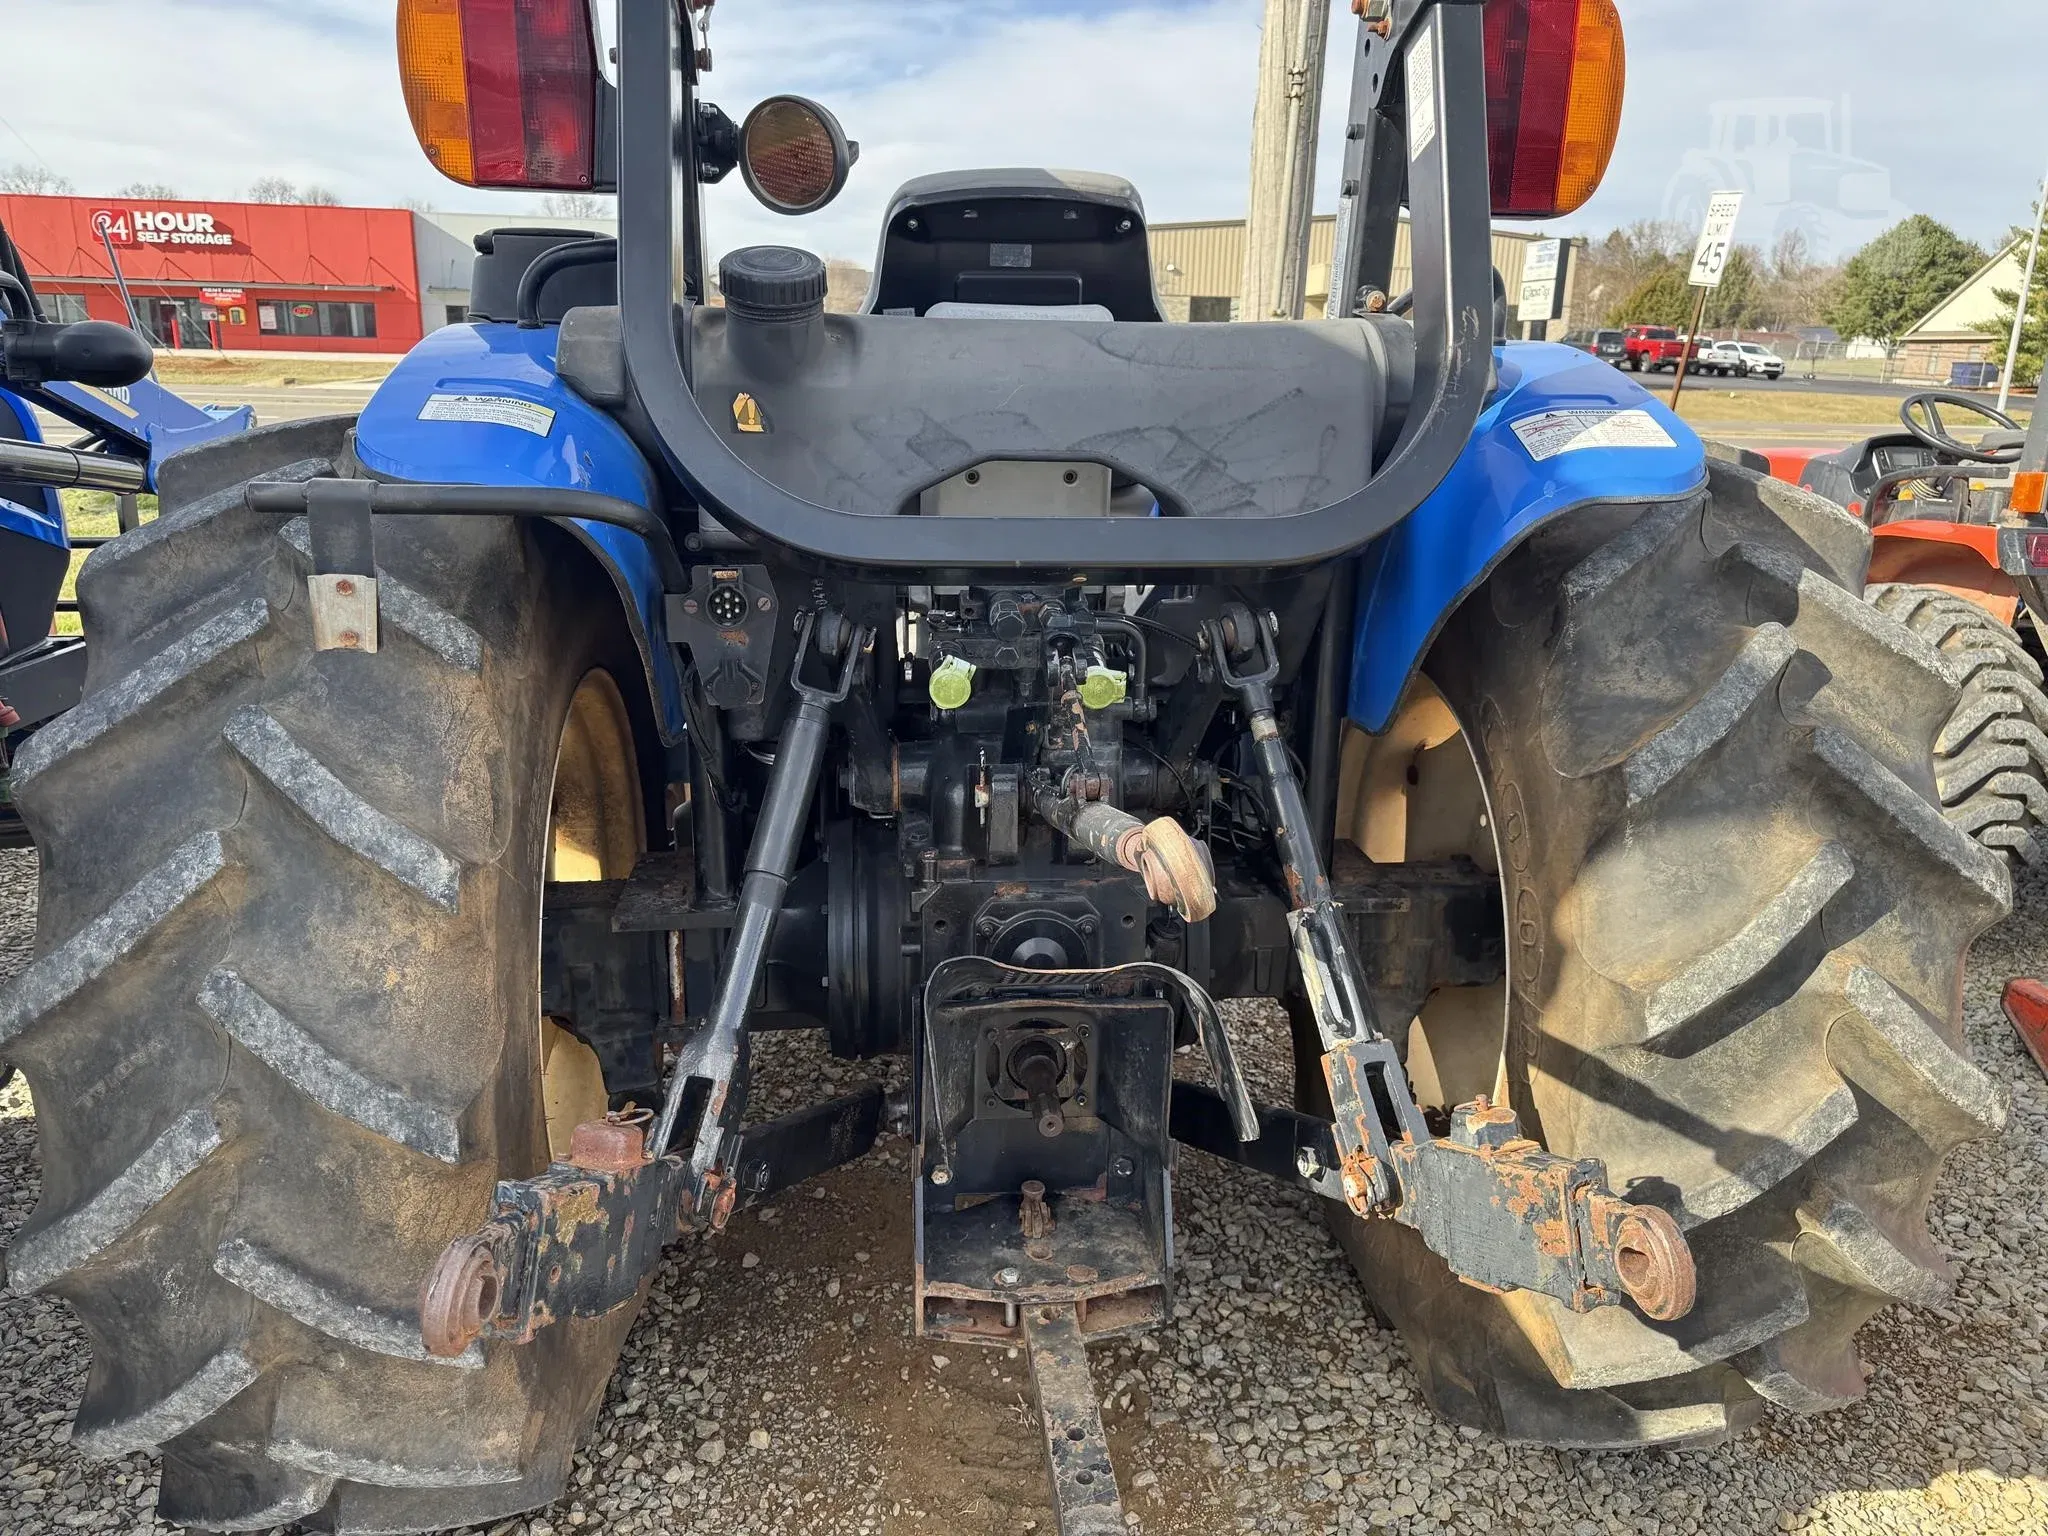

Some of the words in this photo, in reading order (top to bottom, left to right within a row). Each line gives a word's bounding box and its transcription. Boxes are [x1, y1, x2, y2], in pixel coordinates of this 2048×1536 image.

[1709, 203, 1737, 217] SPEED
[95, 212, 129, 241] 24
[133, 210, 215, 233] HOUR
[1706, 223, 1730, 236] LIMIT
[136, 230, 169, 243] SELF
[170, 232, 232, 245] STORAGE
[1697, 242, 1726, 274] 45
[474, 397, 532, 408] WARNING
